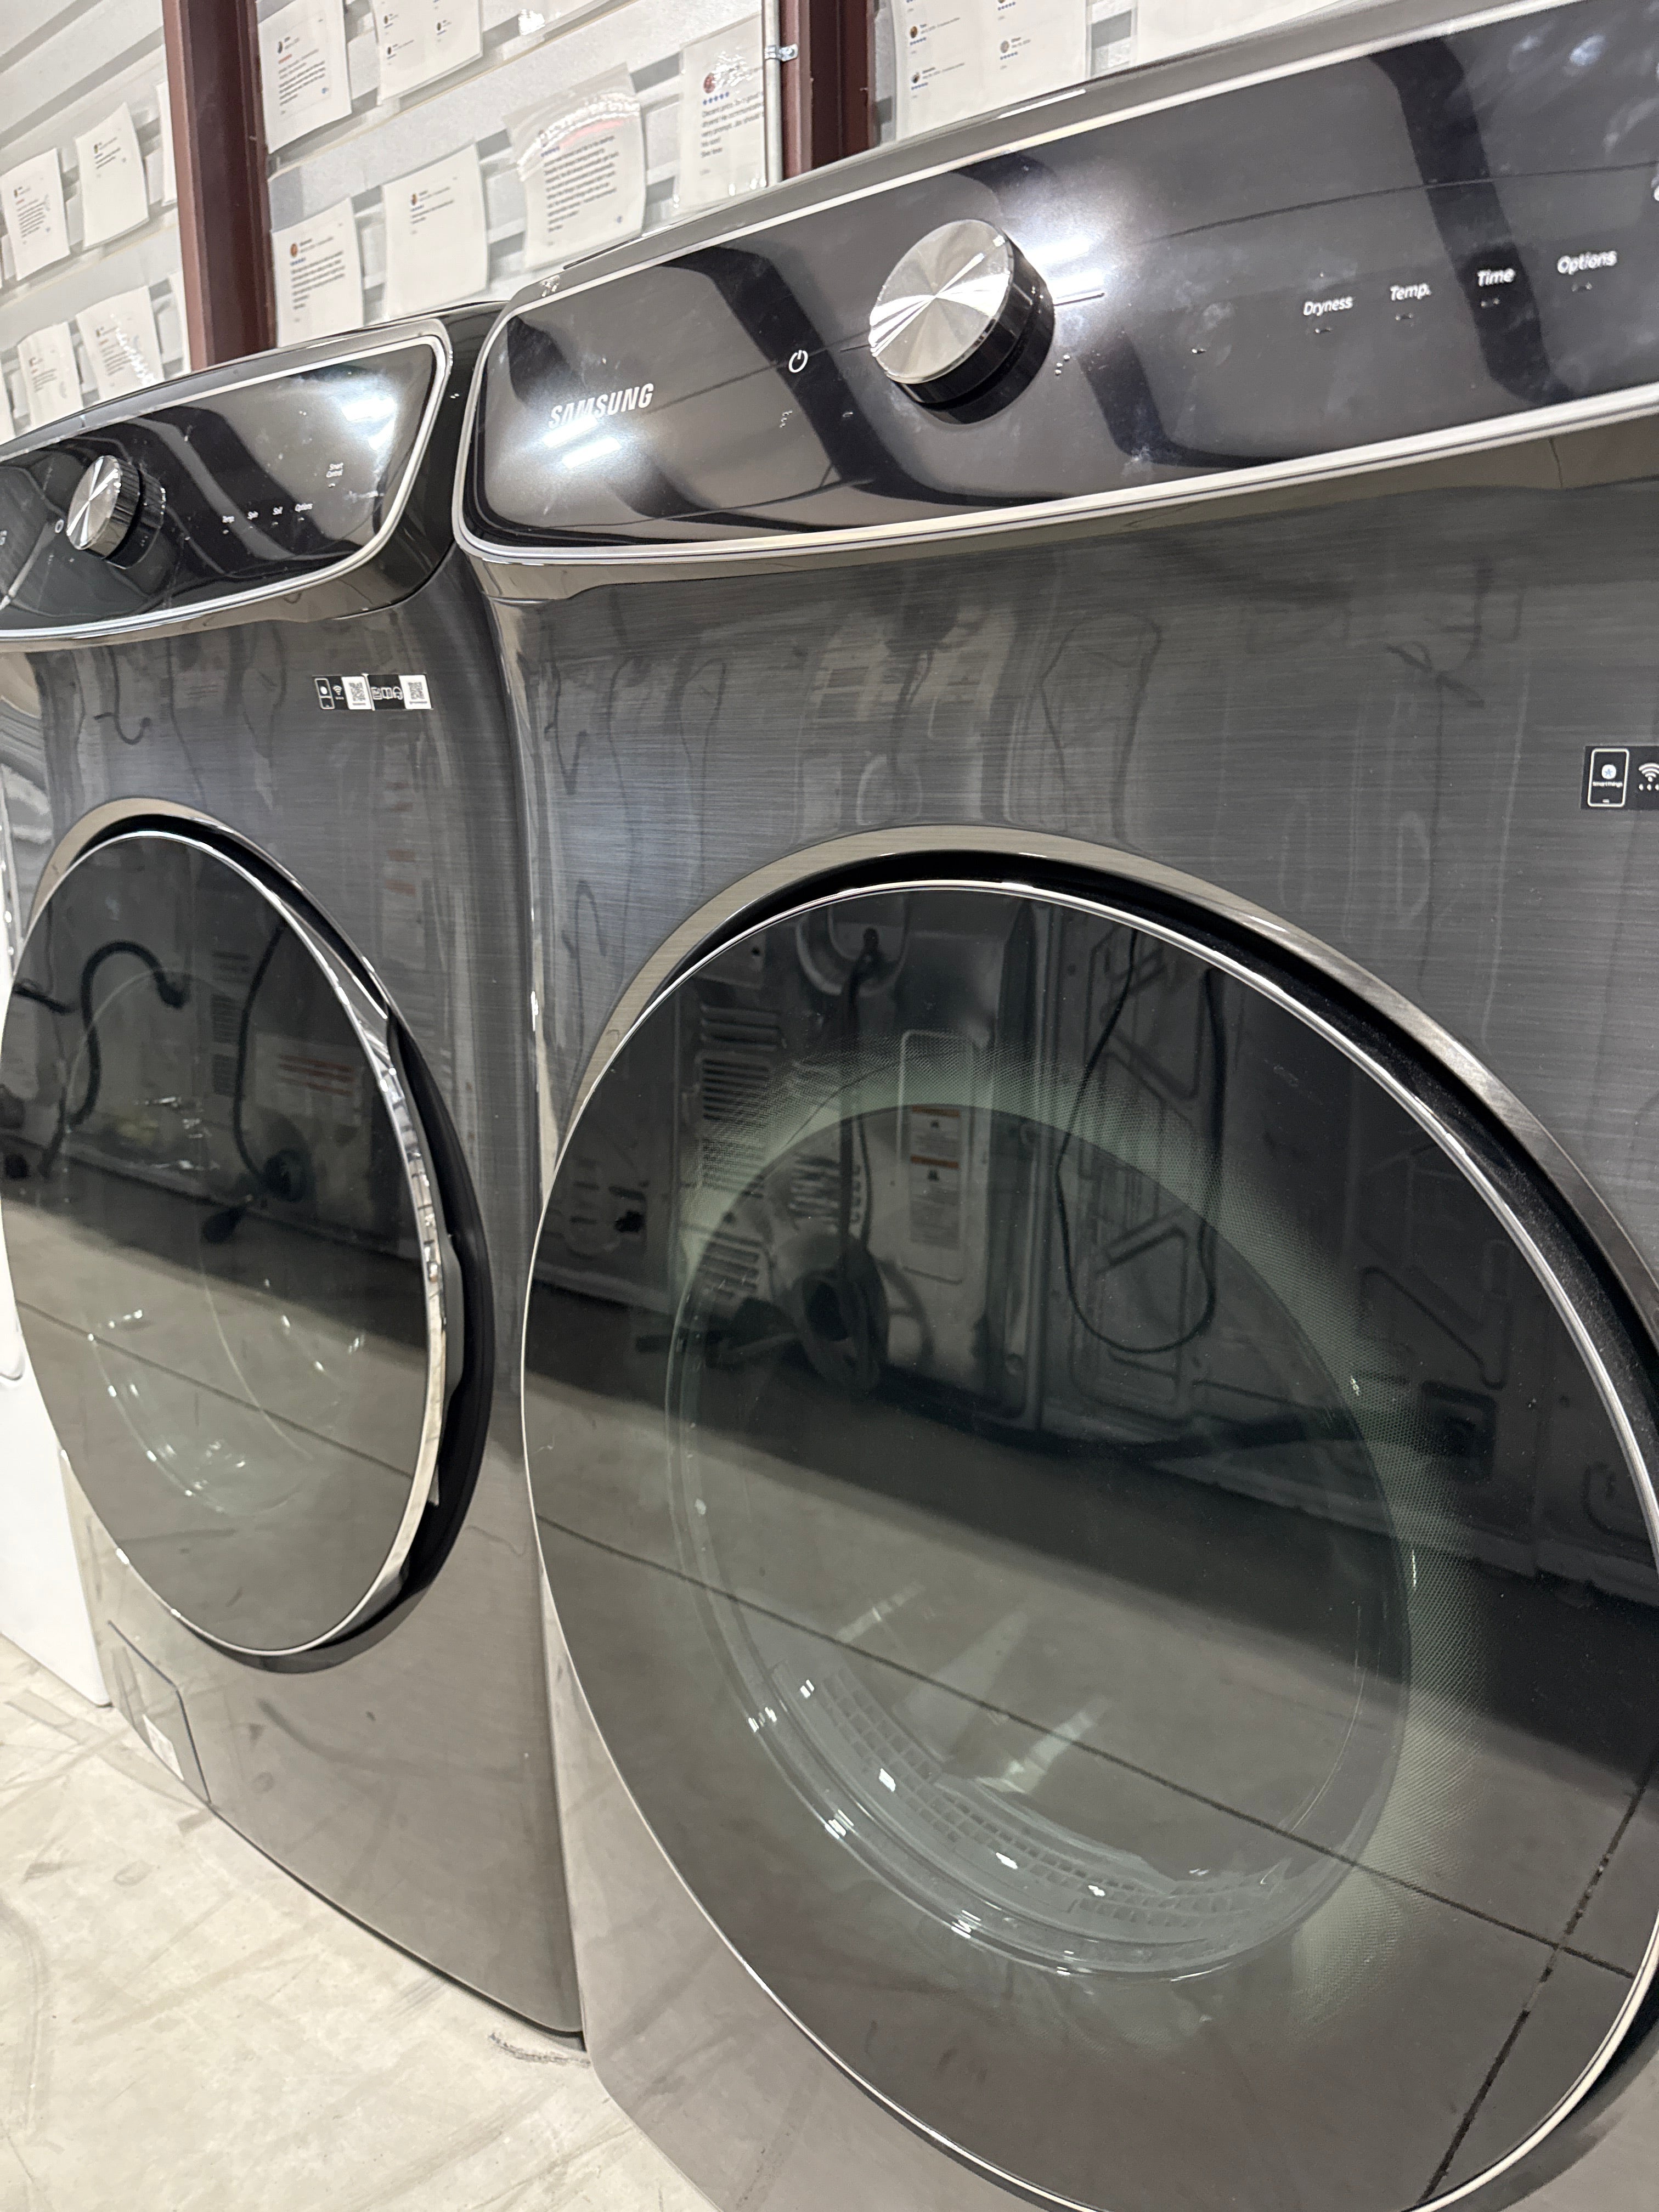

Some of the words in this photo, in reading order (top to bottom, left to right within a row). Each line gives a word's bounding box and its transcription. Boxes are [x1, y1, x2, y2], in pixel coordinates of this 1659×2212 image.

[1557, 250, 1616, 275] Options
[1477, 268, 1515, 287] Time
[1390, 283, 1431, 301] Temp.
[1303, 296, 1353, 316] Dryness
[549, 383, 654, 429] SAMSUNG
